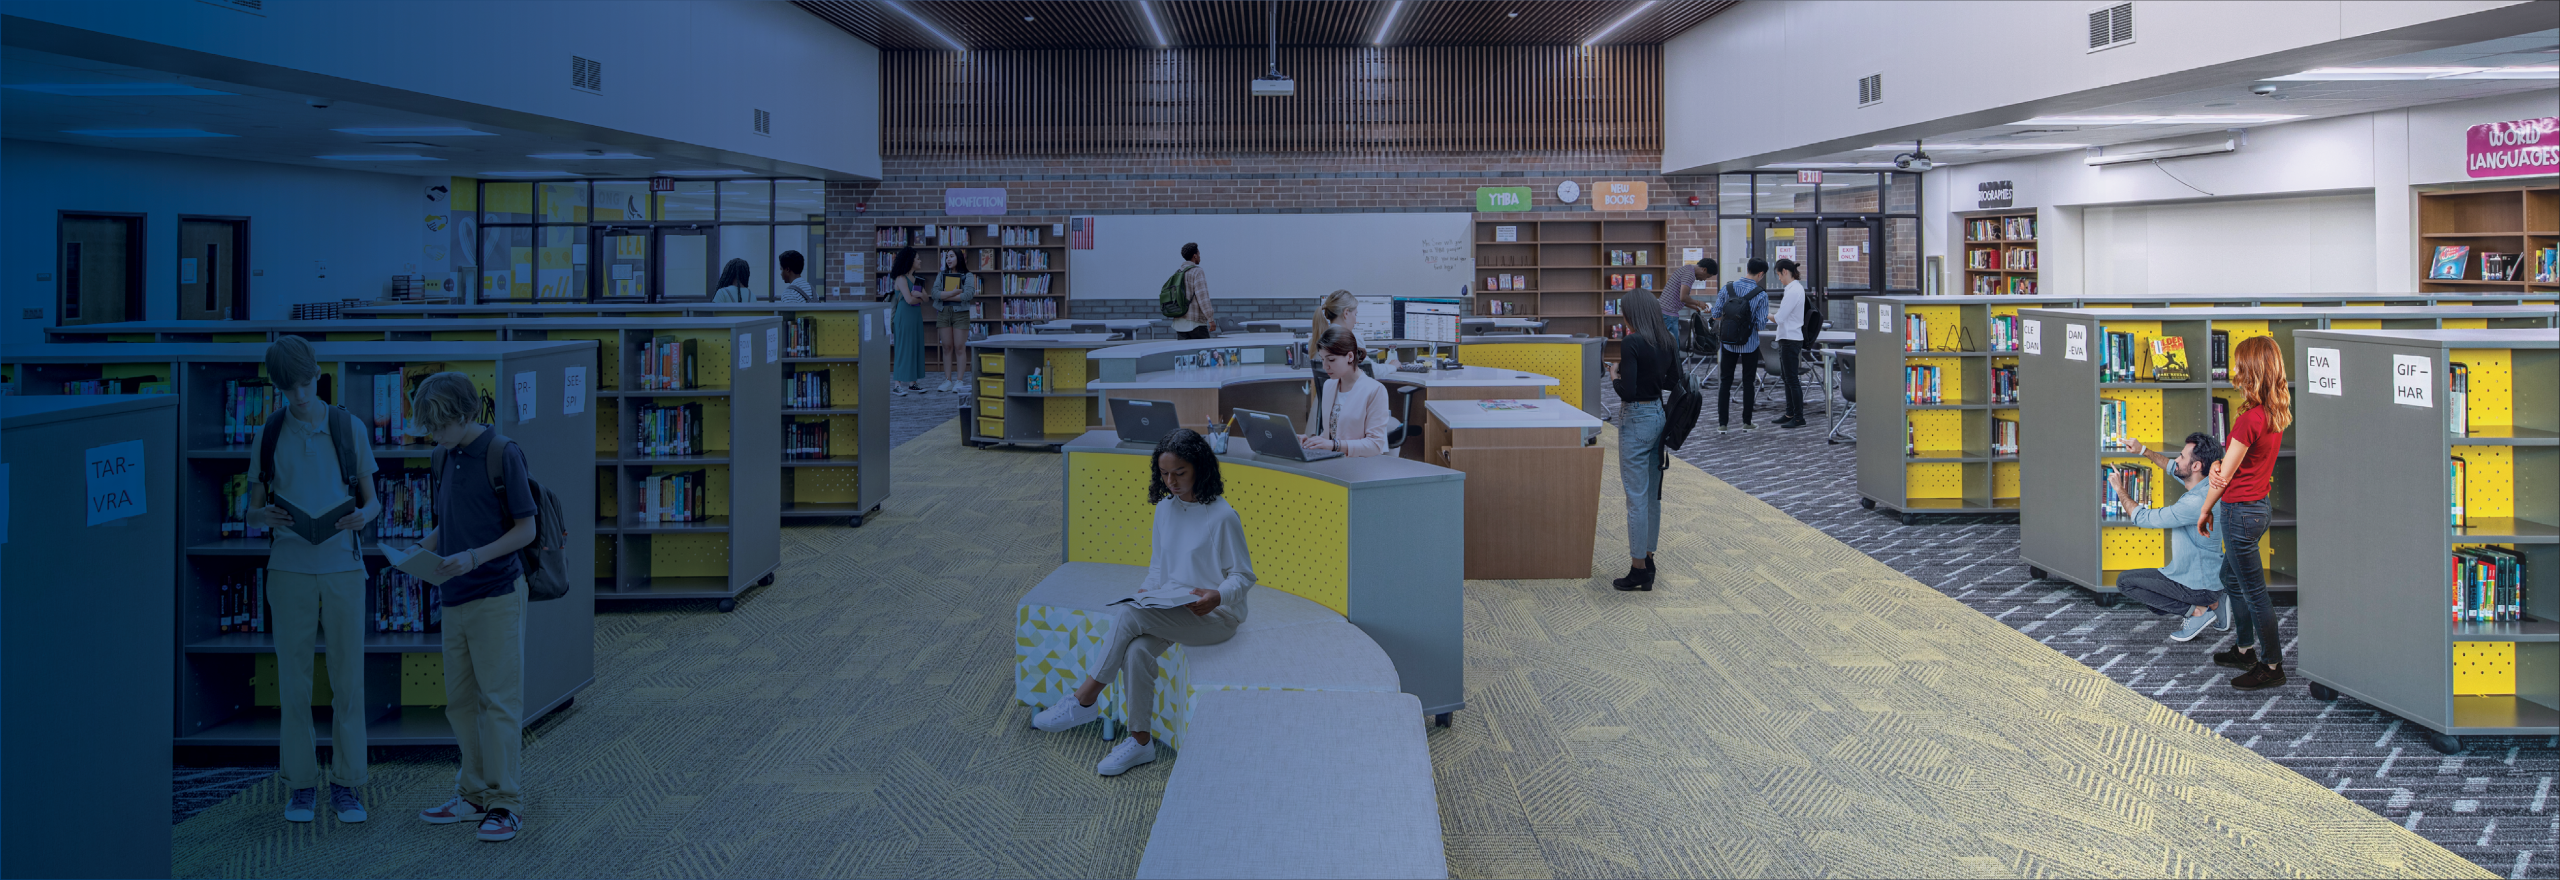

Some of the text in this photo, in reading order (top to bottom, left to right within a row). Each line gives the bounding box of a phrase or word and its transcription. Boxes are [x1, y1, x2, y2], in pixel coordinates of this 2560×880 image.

[2488, 125, 2541, 147] WORLD
[2470, 146, 2559, 171] LANGUAGES
[1801, 171, 1819, 183] EXIT
[654, 179, 670, 190] EXIT
[1610, 183, 1630, 194] NEW
[1488, 192, 1520, 206] YHBA
[1604, 194, 1636, 205] BOOKS
[1979, 188, 2013, 201] BIOGRAPHIES
[948, 196, 1004, 208] NONFICTION
[2023, 325, 2034, 335] CLE
[2068, 330, 2083, 340] DAN
[2024, 340, 2039, 351] -DAN
[2068, 346, 2084, 356] -EVA
[2309, 355, 2330, 368] EVA
[2397, 363, 2417, 376] GIF
[516, 381, 531, 394] PR-
[2319, 377, 2337, 389] GIF
[2397, 386, 2424, 400] HAR
[91, 456, 135, 479] TAR-
[93, 489, 133, 513] VRA
